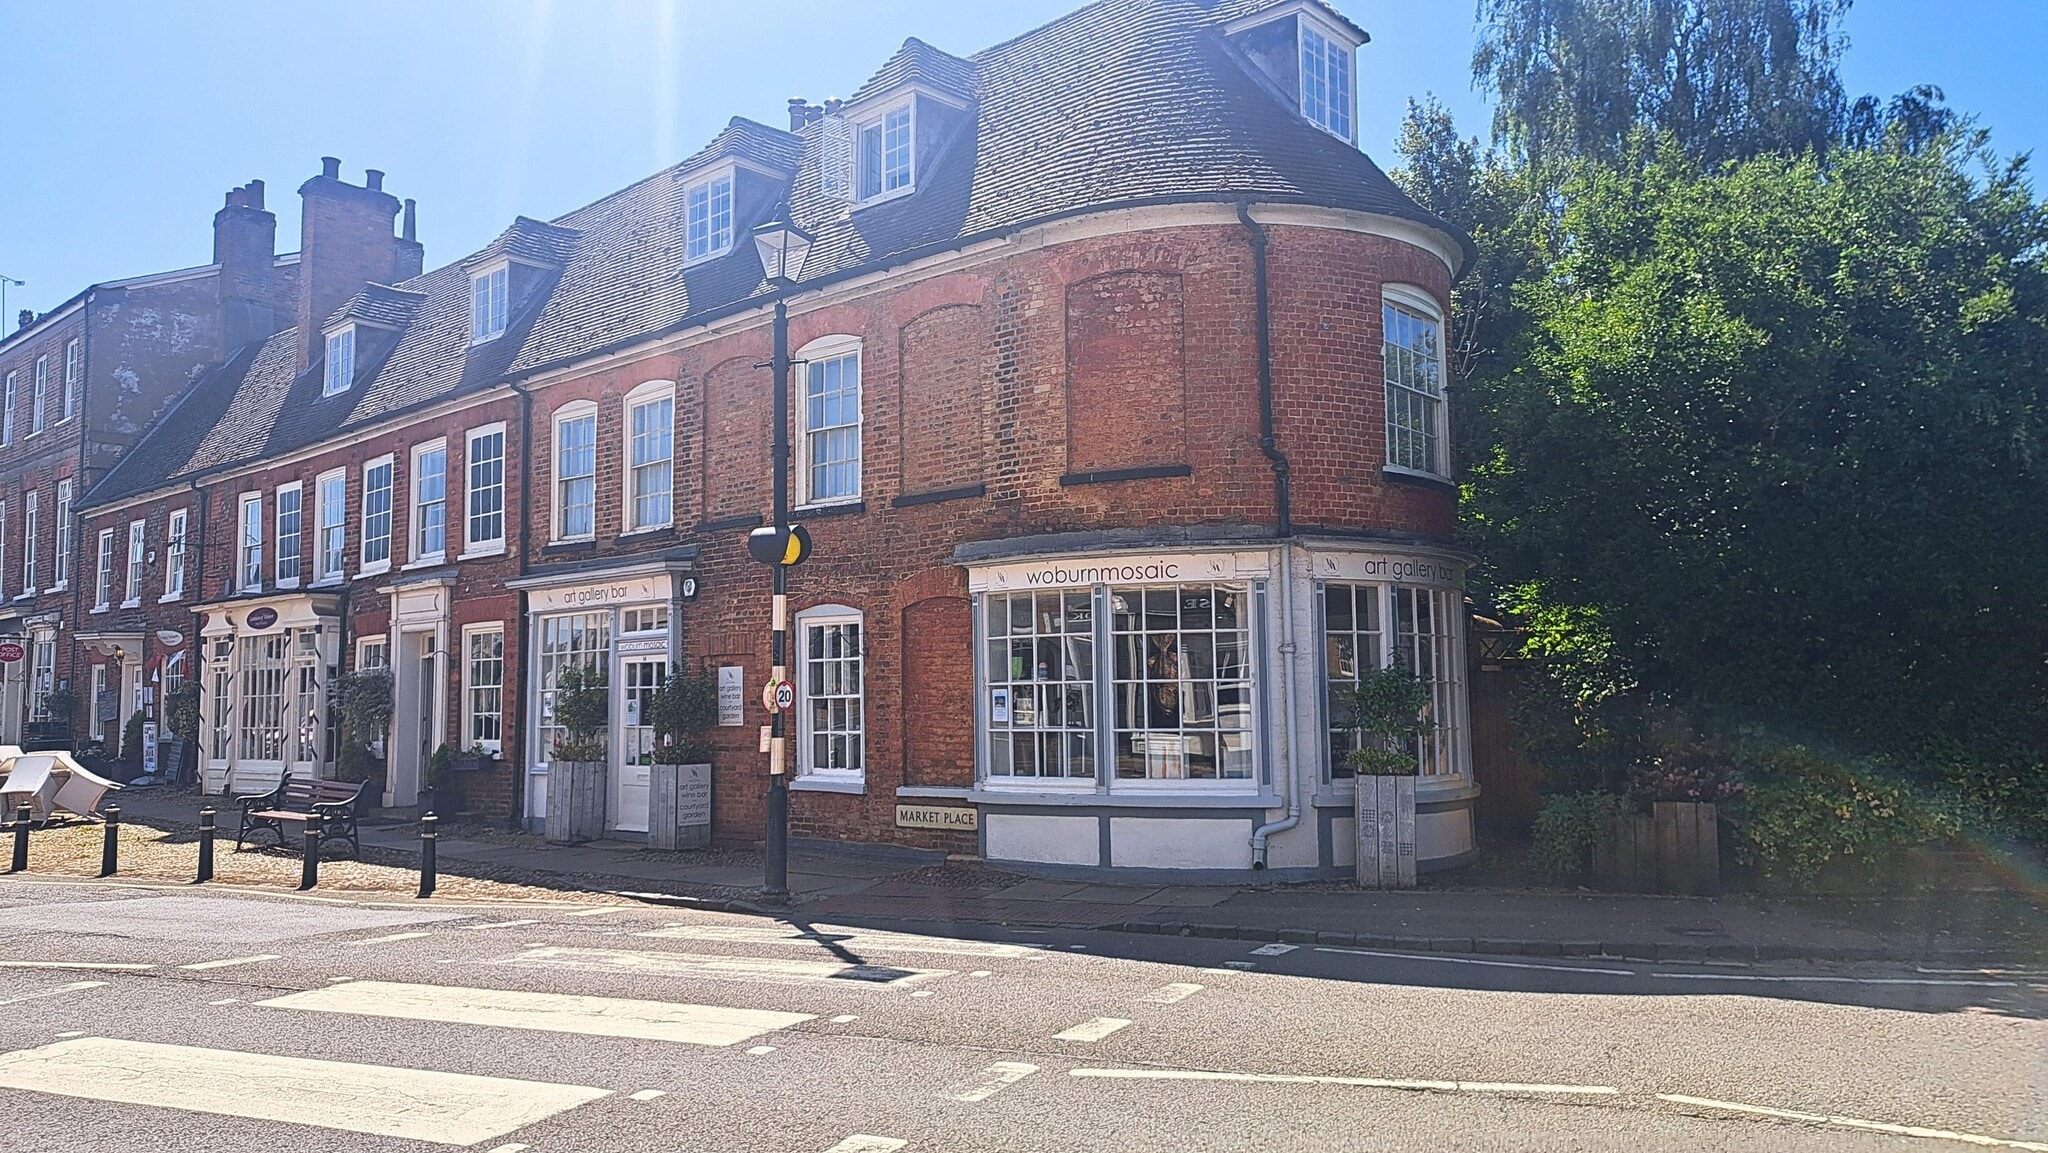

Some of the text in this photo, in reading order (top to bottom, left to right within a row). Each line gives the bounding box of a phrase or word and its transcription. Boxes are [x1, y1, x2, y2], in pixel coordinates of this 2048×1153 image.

[1026, 559, 1179, 585] woburnmosaic
[1364, 557, 1388, 575] art
[1392, 559, 1437, 582] gallery
[563, 585, 628, 605] art gallery bar
[726, 684, 742, 693] gallery
[778, 690, 791, 703] 20
[719, 704, 742, 712] courtyard
[689, 782, 710, 791] gallery
[679, 802, 709, 811] courtyard
[682, 811, 706, 820] garden
[900, 810, 974, 825] MARKET PLACE
